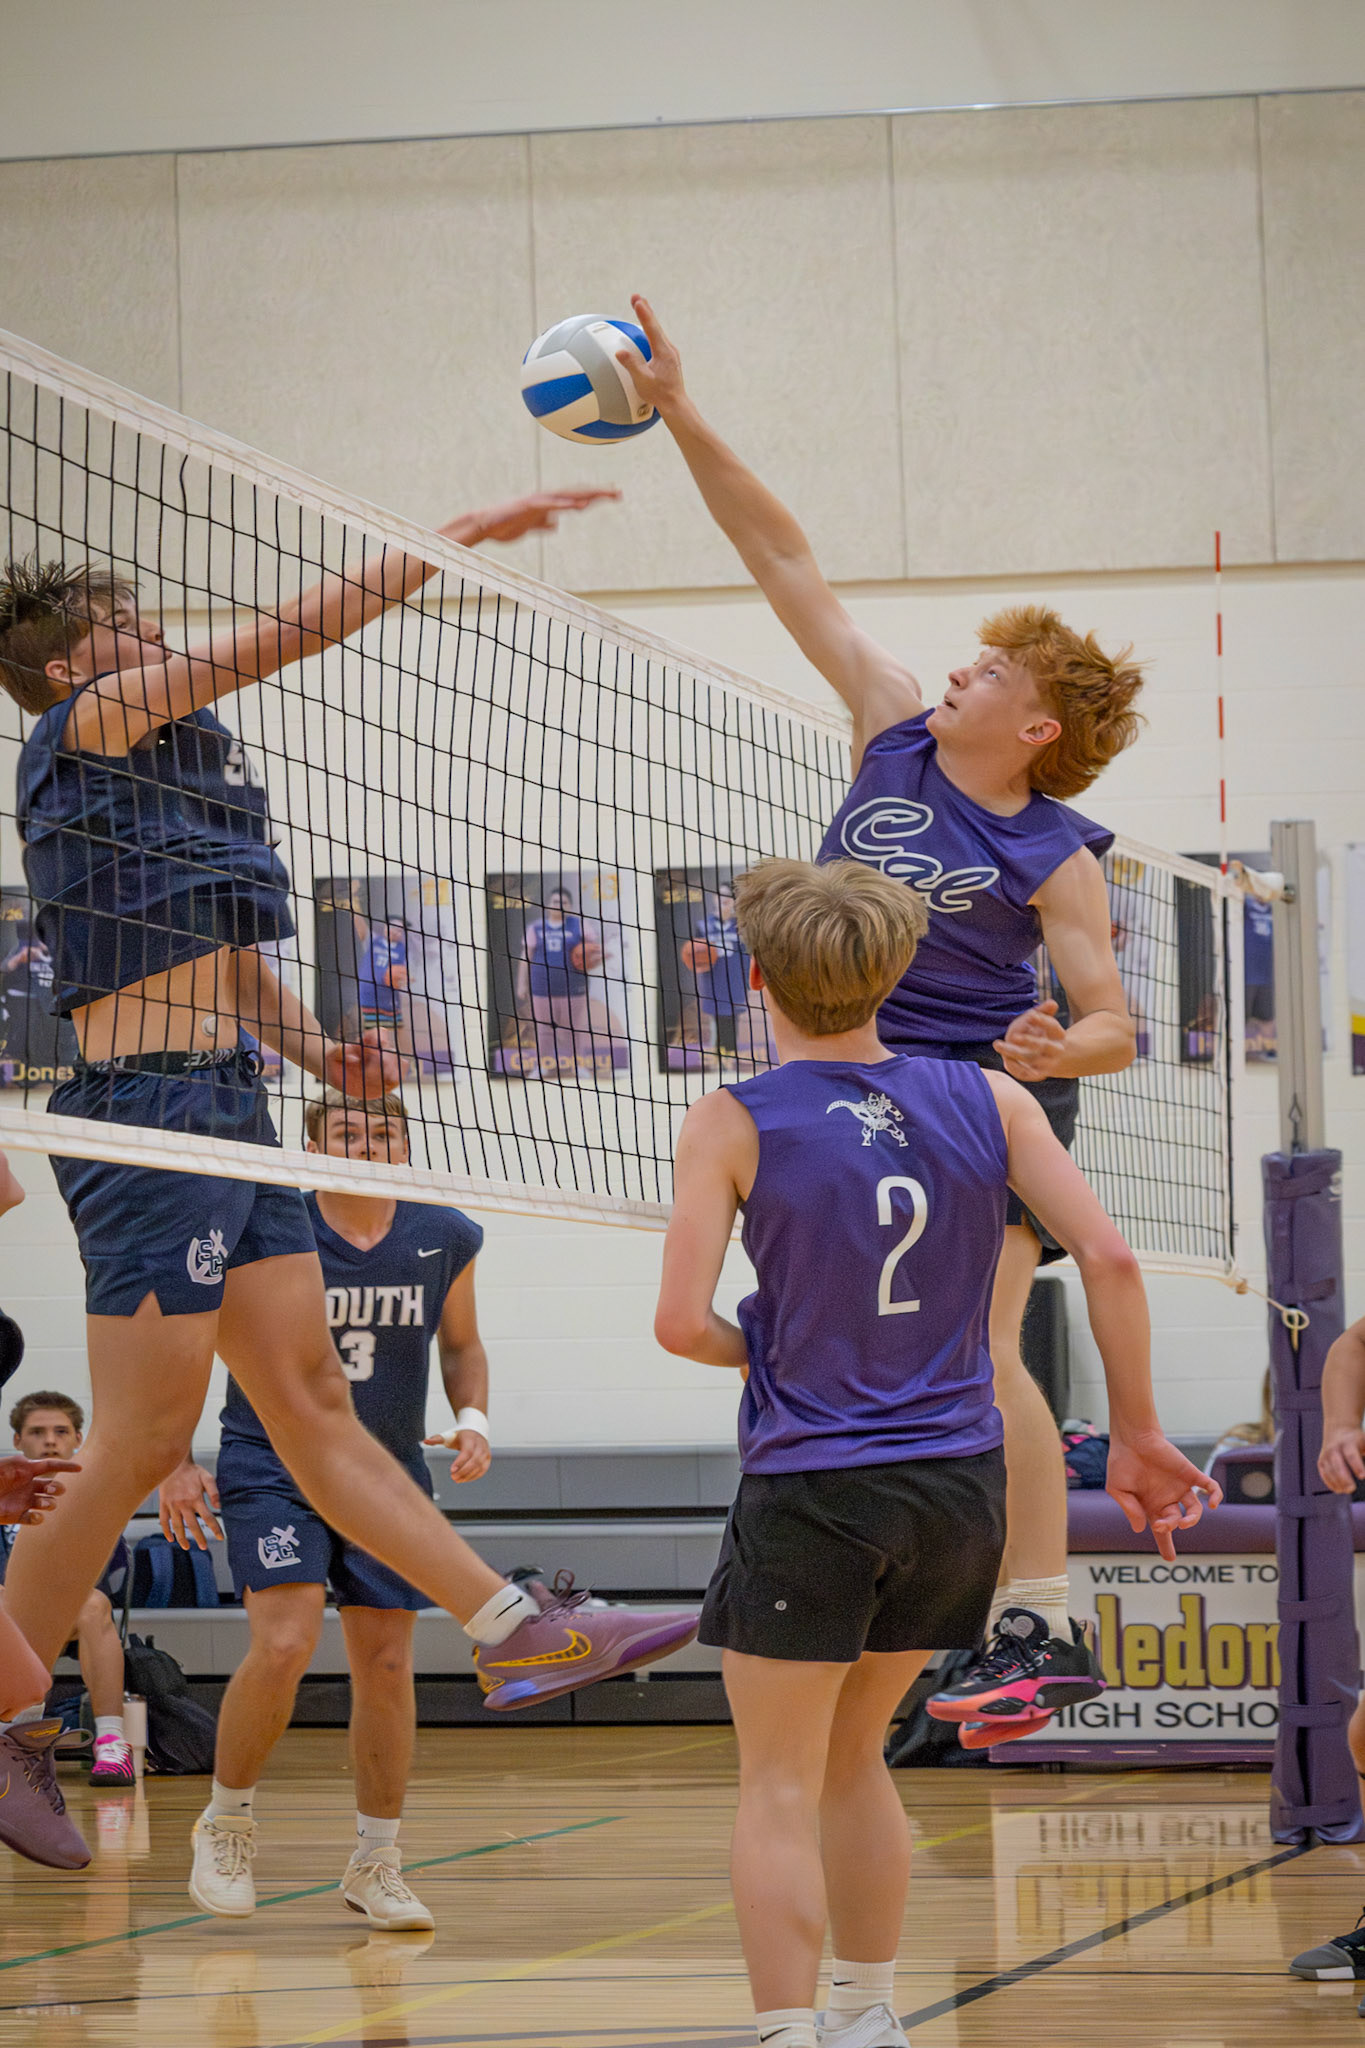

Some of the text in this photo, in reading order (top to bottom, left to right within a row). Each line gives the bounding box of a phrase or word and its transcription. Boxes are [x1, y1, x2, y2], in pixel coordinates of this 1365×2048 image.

[876, 1176, 928, 1316] 2
[1090, 1565, 1279, 1584] WELCOME TO
[1084, 1593, 1281, 1690] ledon
